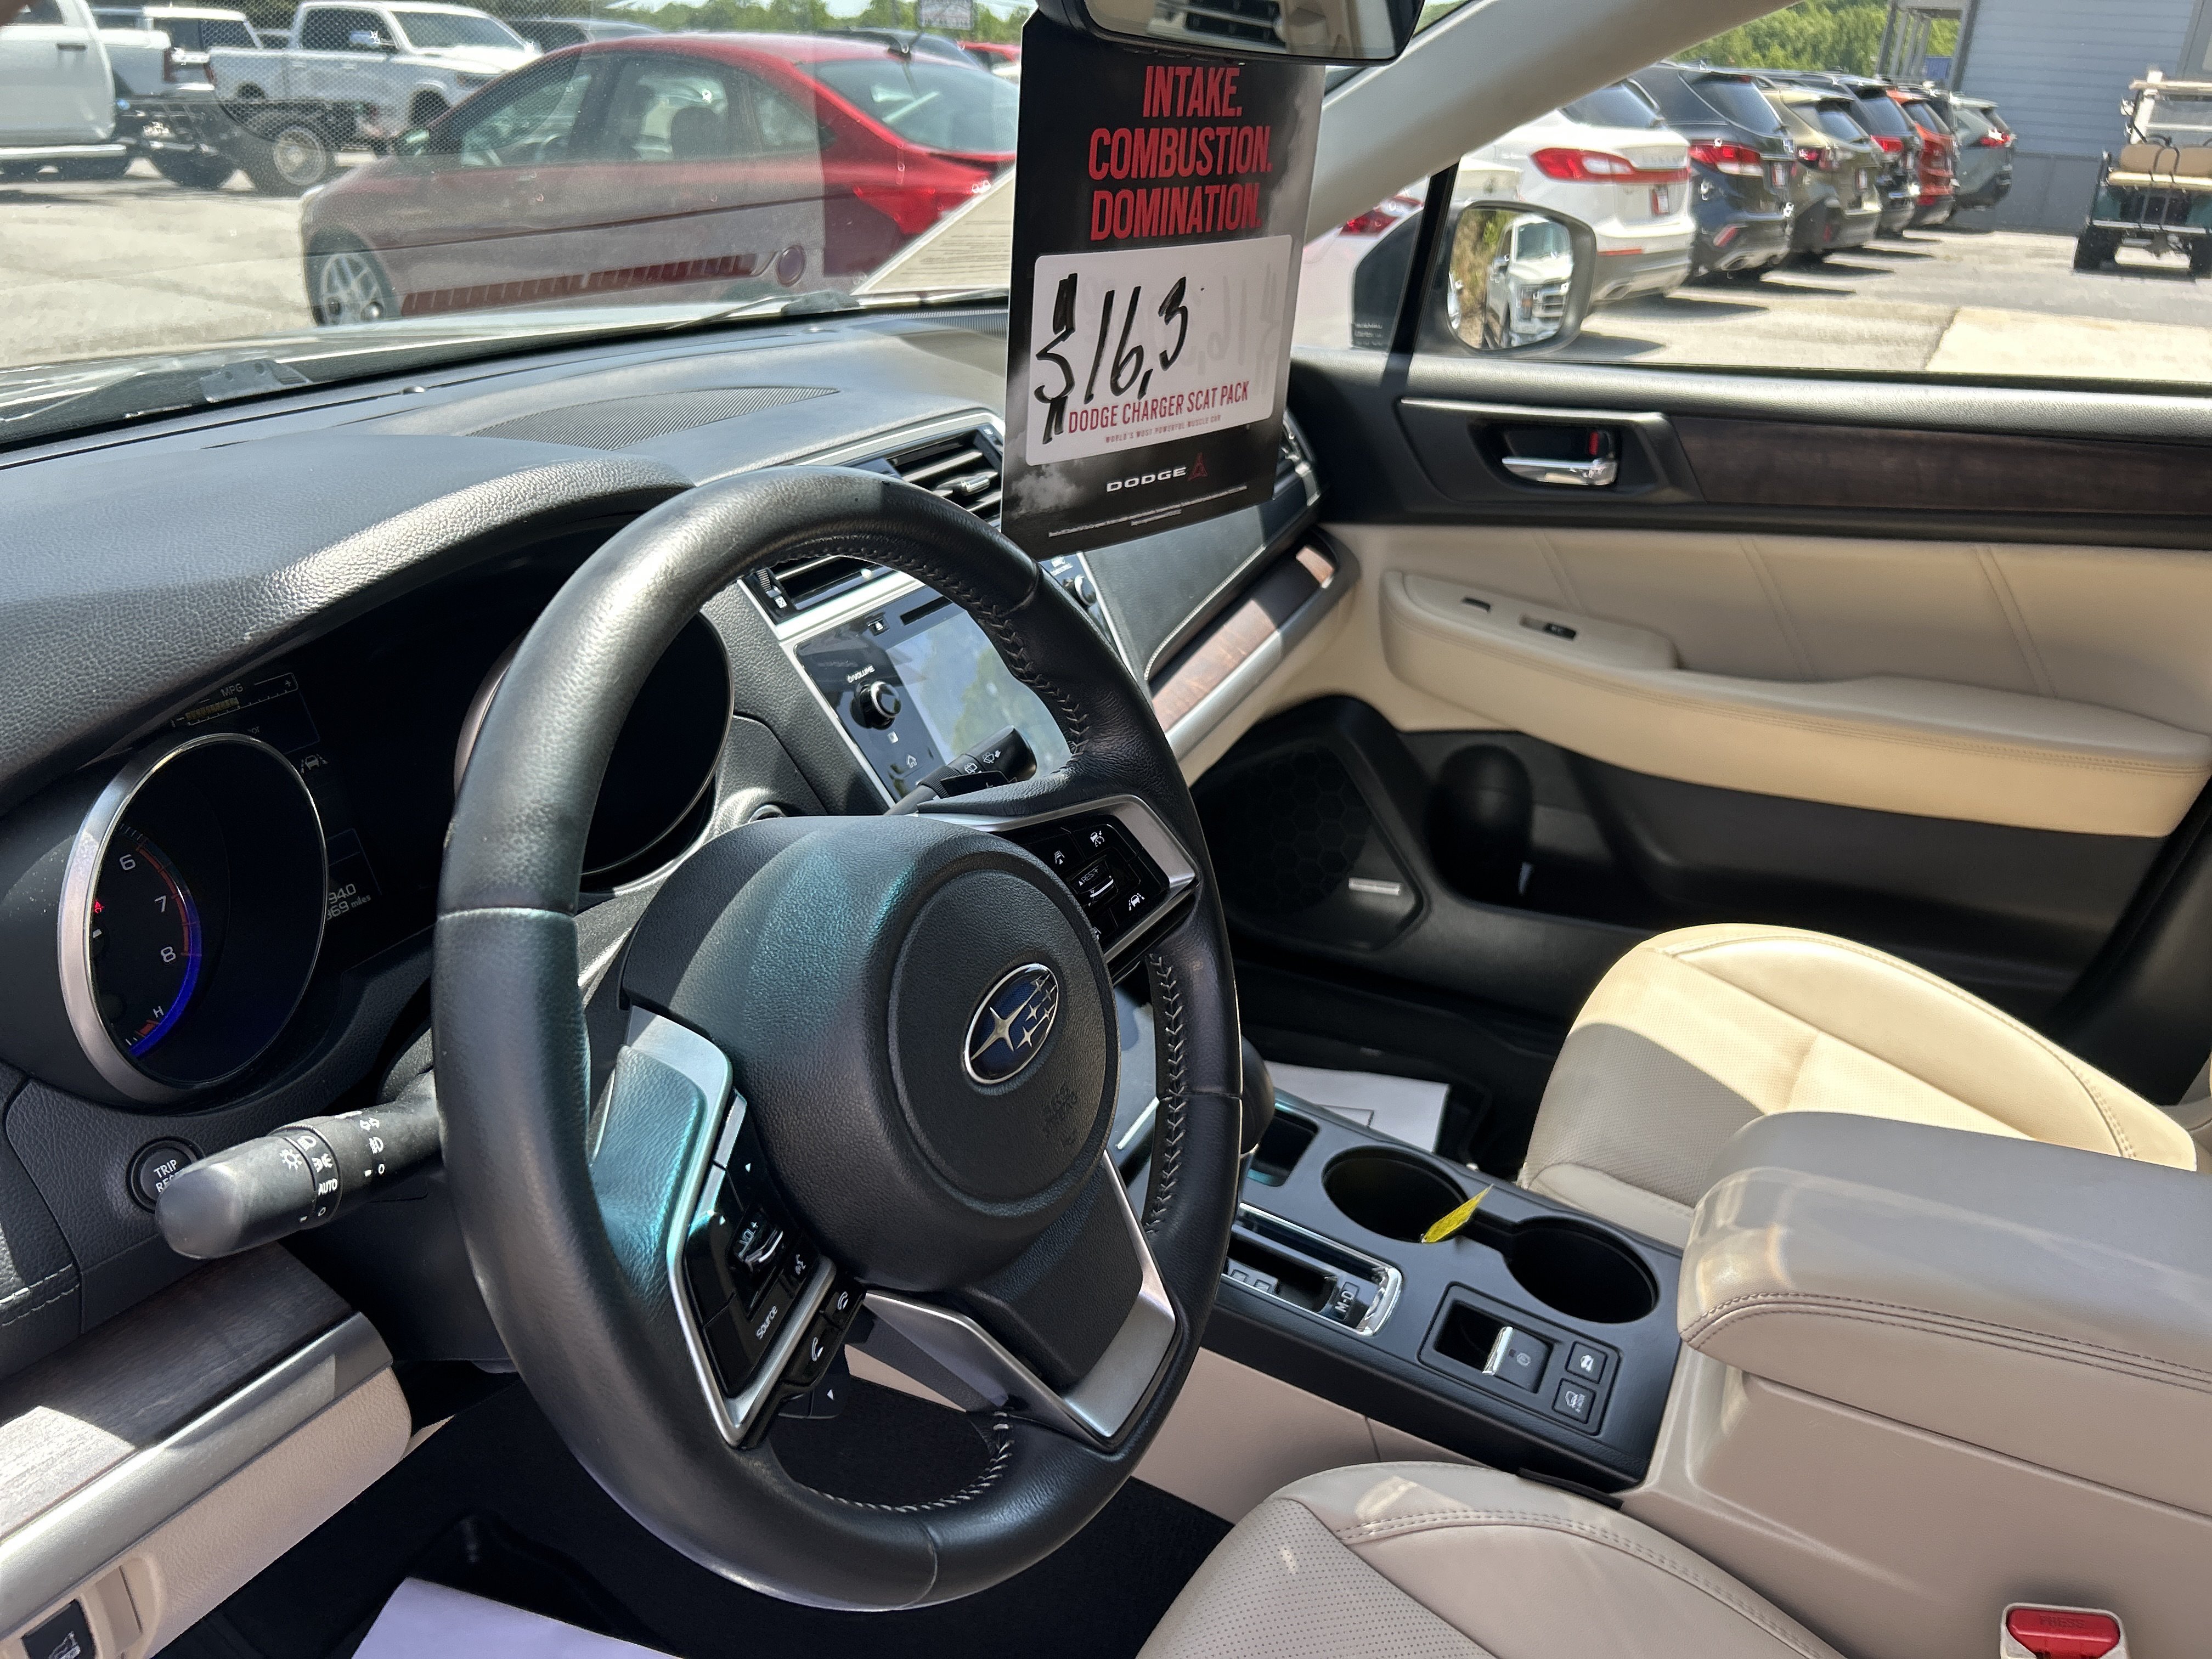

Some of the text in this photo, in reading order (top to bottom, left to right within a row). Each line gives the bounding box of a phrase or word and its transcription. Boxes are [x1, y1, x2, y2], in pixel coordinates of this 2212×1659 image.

[1142, 65, 1243, 118] INTAKE.
[1088, 126, 1273, 180] COMBUSTION.
[1090, 183, 1261, 241] DOMINATION.
[1068, 380, 1250, 433] DODGE CHARGER SCAT PACK
[1154, 422, 1186, 434] POWERFUL
[1187, 417, 1209, 428] MUSCLE
[1107, 466, 1188, 493] DODGE
[221, 683, 244, 697] MPG
[120, 854, 136, 871] 6
[154, 895, 166, 913] 7
[351, 895, 371, 908] miles
[161, 946, 177, 963] 8
[154, 1159, 177, 1178] TRIP
[318, 1178, 338, 1196] AUTO
